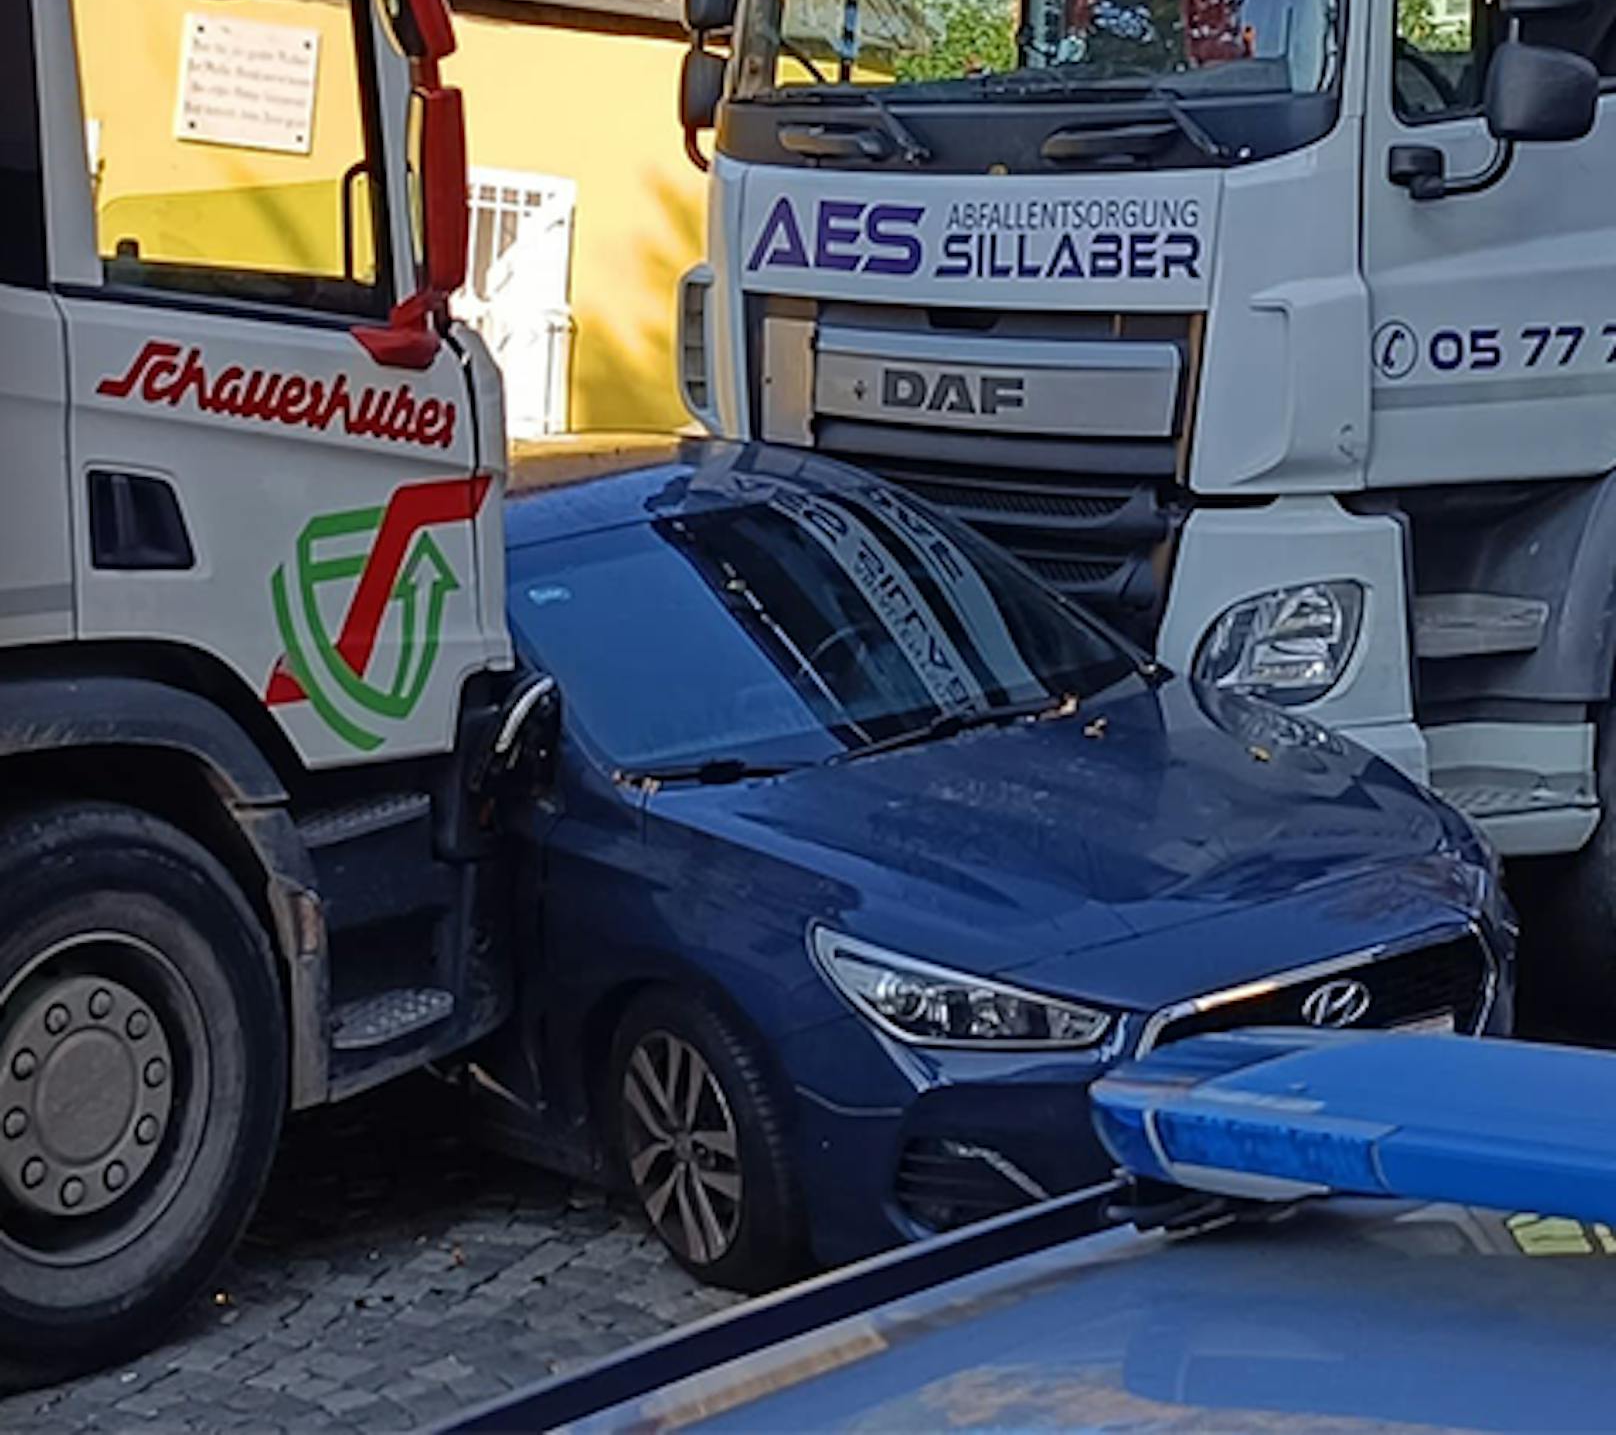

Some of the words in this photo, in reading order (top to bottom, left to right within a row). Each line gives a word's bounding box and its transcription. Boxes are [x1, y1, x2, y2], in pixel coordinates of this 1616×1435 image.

[746, 196, 924, 275] AES
[948, 200, 1199, 230] ABFALLENTSORGUNG
[934, 234, 1201, 278] SILLABER
[1430, 331, 1501, 370] 05
[1521, 328, 1585, 367] 77
[96, 341, 456, 448] Schauerhuber
[881, 369, 1025, 414] DAF
